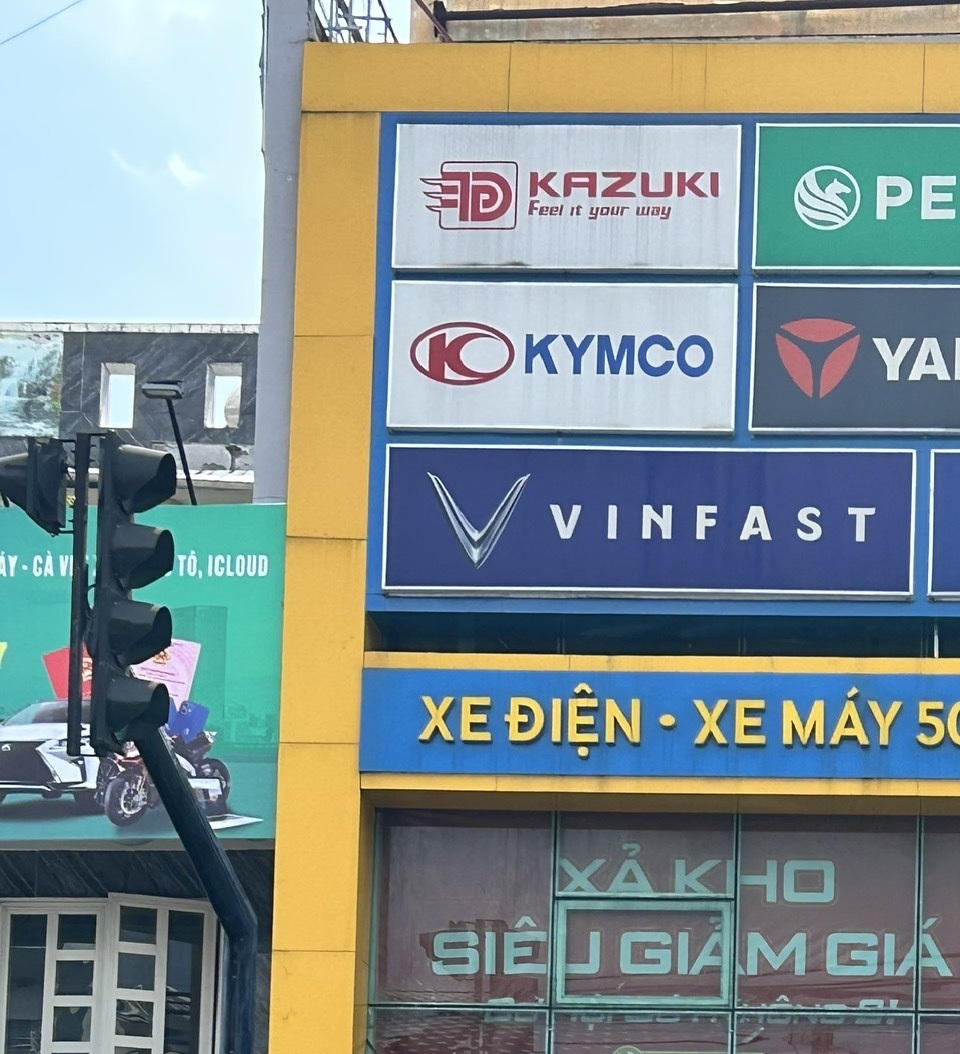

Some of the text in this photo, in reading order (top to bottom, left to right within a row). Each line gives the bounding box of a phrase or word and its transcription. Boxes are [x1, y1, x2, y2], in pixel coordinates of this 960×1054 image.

[529, 171, 719, 198] KAZUKI
[528, 200, 671, 220] Feel it your way
[525, 333, 714, 378] KYMCO
[549, 504, 876, 543] VINFAST
[33, 550, 54, 577] CÀ
[207, 554, 268, 577] ICLOUD
[419, 695, 492, 742] XE
[504, 683, 642, 758] ĐIỆN
[693, 698, 766, 746] XE
[782, 687, 902, 748] MÁY
[559, 843, 835, 903] XẢ KHO
[432, 915, 600, 975] SIÊU
[826, 917, 953, 976] GIÁ
